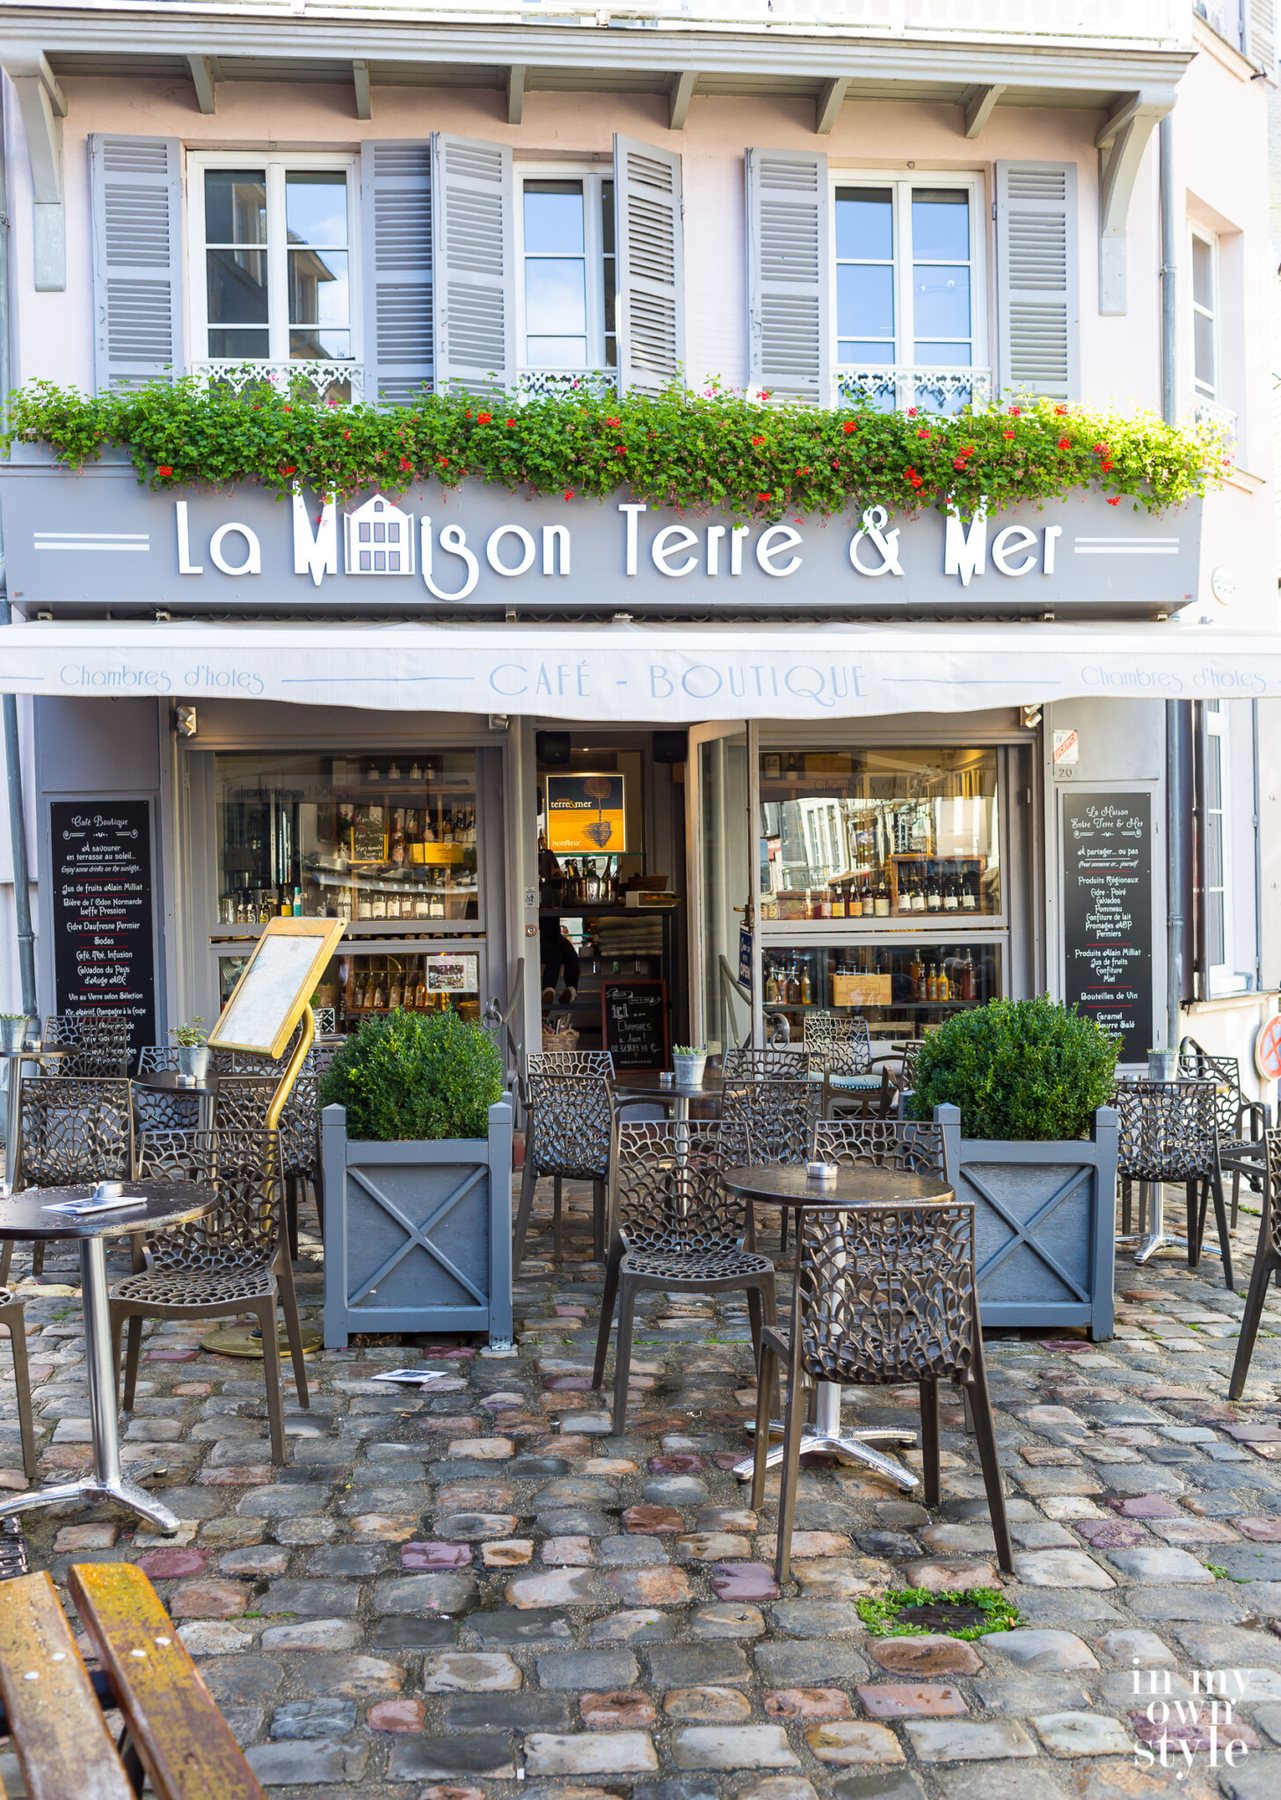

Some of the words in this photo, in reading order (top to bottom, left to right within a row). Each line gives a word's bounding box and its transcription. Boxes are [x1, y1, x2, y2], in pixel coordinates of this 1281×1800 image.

[176, 500, 262, 575] La
[619, 504, 803, 577] Terre
[849, 504, 904, 576] &
[944, 489, 1062, 586] Mer
[60, 664, 171, 692] Chambres
[1080, 666, 1184, 694] Chambres
[489, 660, 591, 696] CAFÉ
[649, 664, 868, 707] BOUTIQUE
[1058, 768, 1072, 777] 20
[1100, 805, 1128, 818] Maison
[93, 815, 128, 828] Boutique
[1093, 818, 1114, 828] Terre
[1116, 819, 1124, 828] &
[1128, 848, 1139, 856] pas
[1078, 876, 1105, 886] Produits
[62, 885, 74, 895] Jus
[85, 884, 102, 894] fruits
[113, 898, 142, 907] Normande
[99, 907, 126, 916] Pression
[94, 936, 114, 945] Sodas
[108, 950, 133, 960] Infusion
[1074, 949, 1101, 959] Produits
[1112, 957, 1128, 967] fruits
[105, 966, 113, 974] du
[115, 964, 130, 975] Pays
[1081, 992, 1114, 1000] Bouteilles
[1097, 1012, 1122, 1021] Caramel
[1120, 1020, 1135, 1028] Salé
